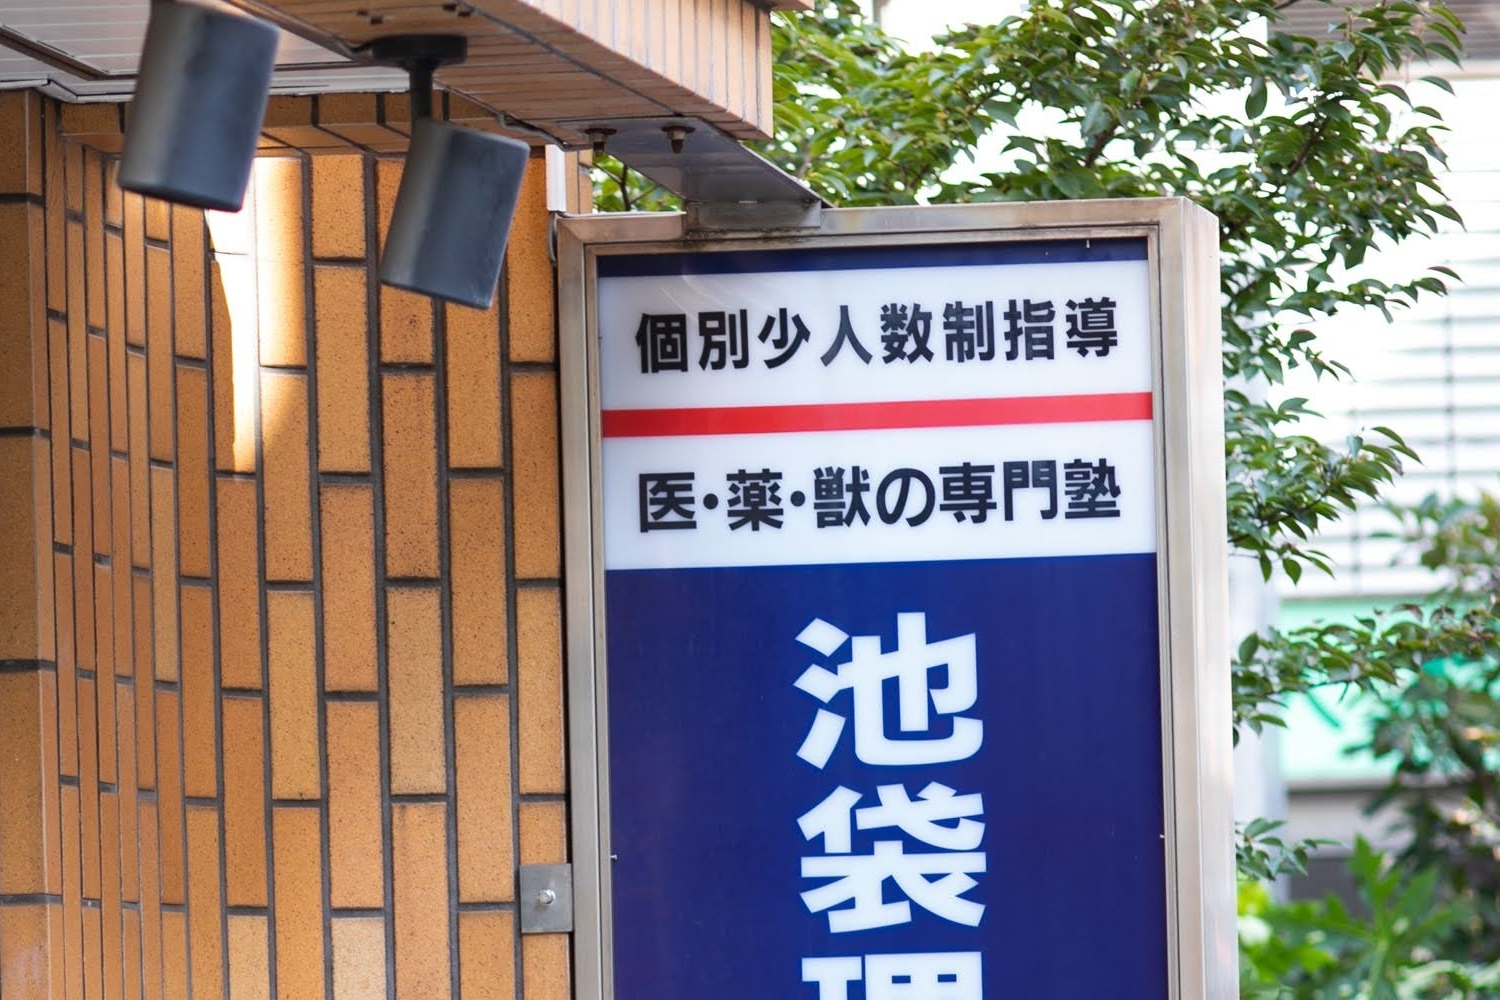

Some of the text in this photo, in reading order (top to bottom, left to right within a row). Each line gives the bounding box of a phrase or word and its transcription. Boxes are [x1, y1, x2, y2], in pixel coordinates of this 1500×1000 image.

[635, 297, 1119, 374] 個別少人数制指導
[637, 458, 1120, 533] 医・薬・獣の専門塾
